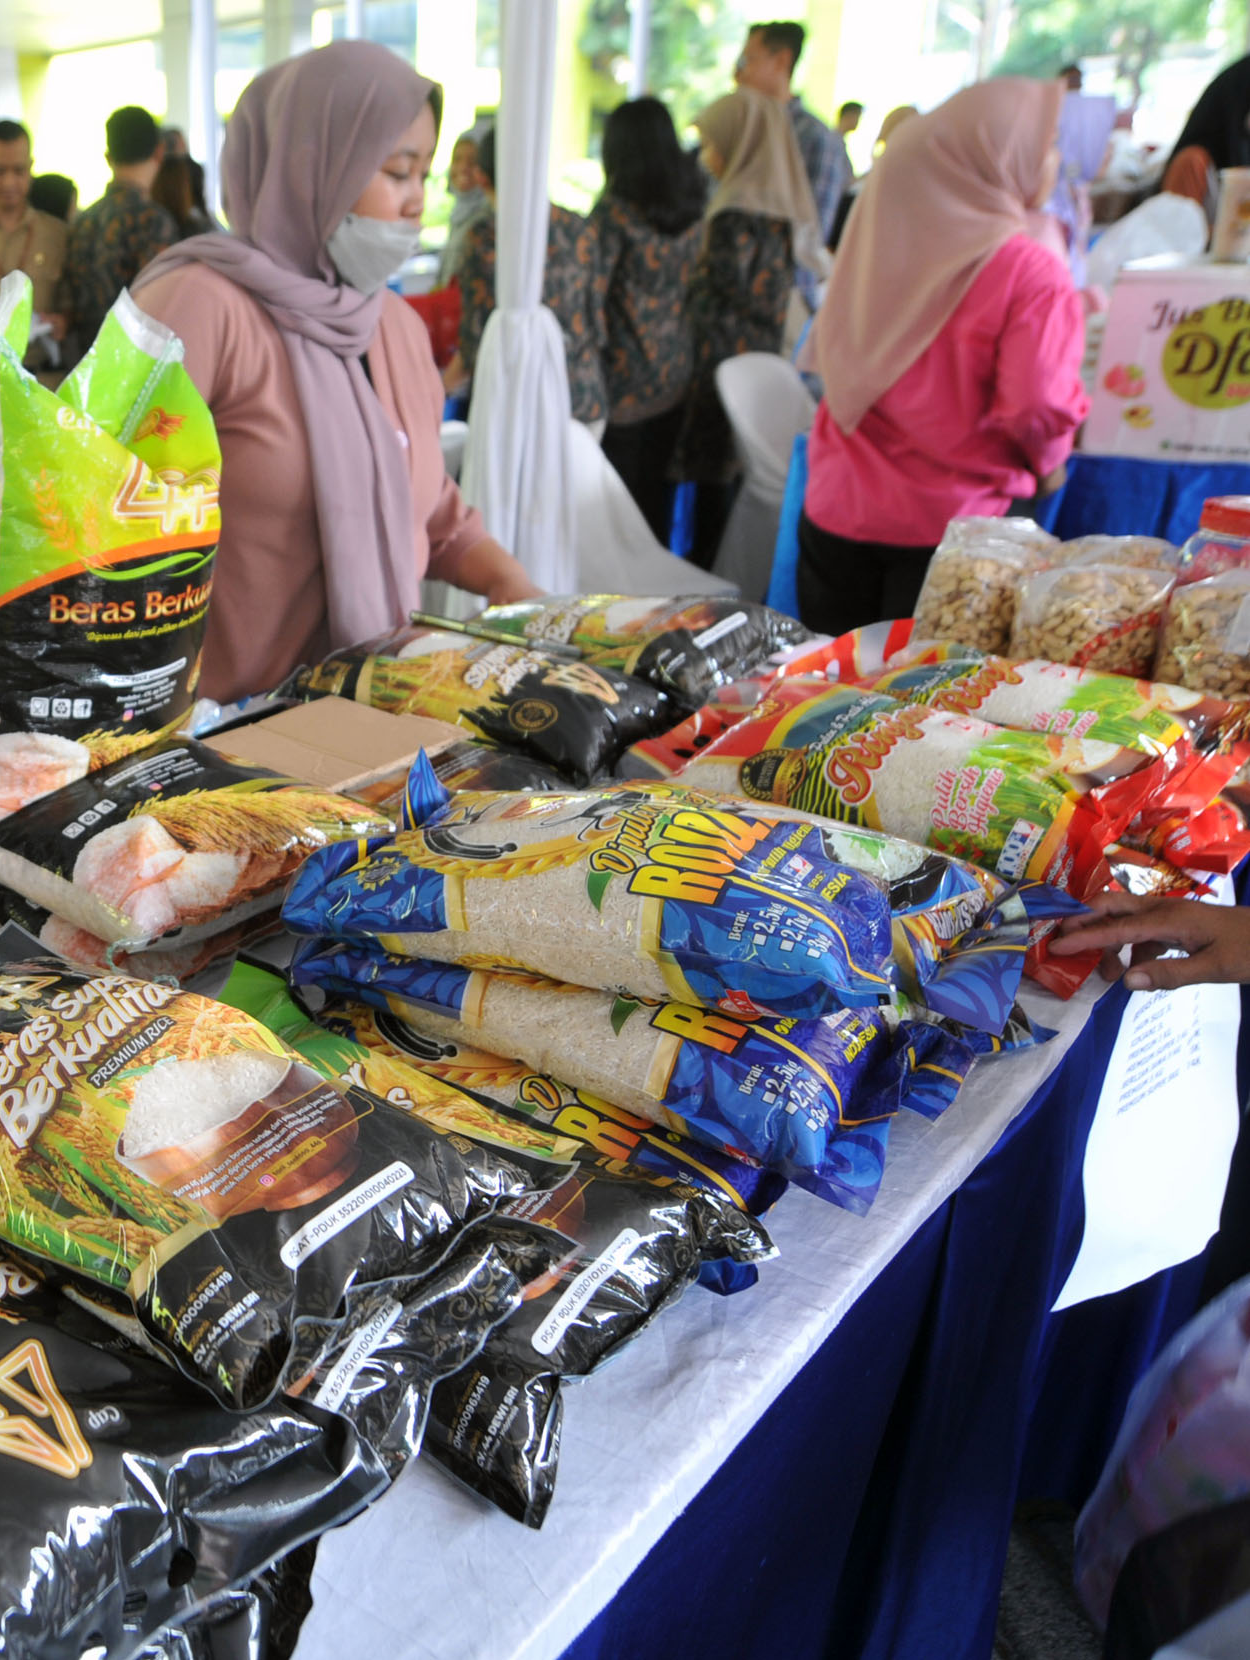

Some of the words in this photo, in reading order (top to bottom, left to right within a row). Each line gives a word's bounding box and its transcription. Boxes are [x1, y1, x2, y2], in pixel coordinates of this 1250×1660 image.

[49, 593, 136, 623] Beras
[50, 975, 127, 1021] Supe
[89, 1034, 149, 1088] PREMIUM
[147, 1015, 176, 1044] RICE
[87, 1404, 122, 1431] Cap
[487, 1402, 510, 1438] DEWI
